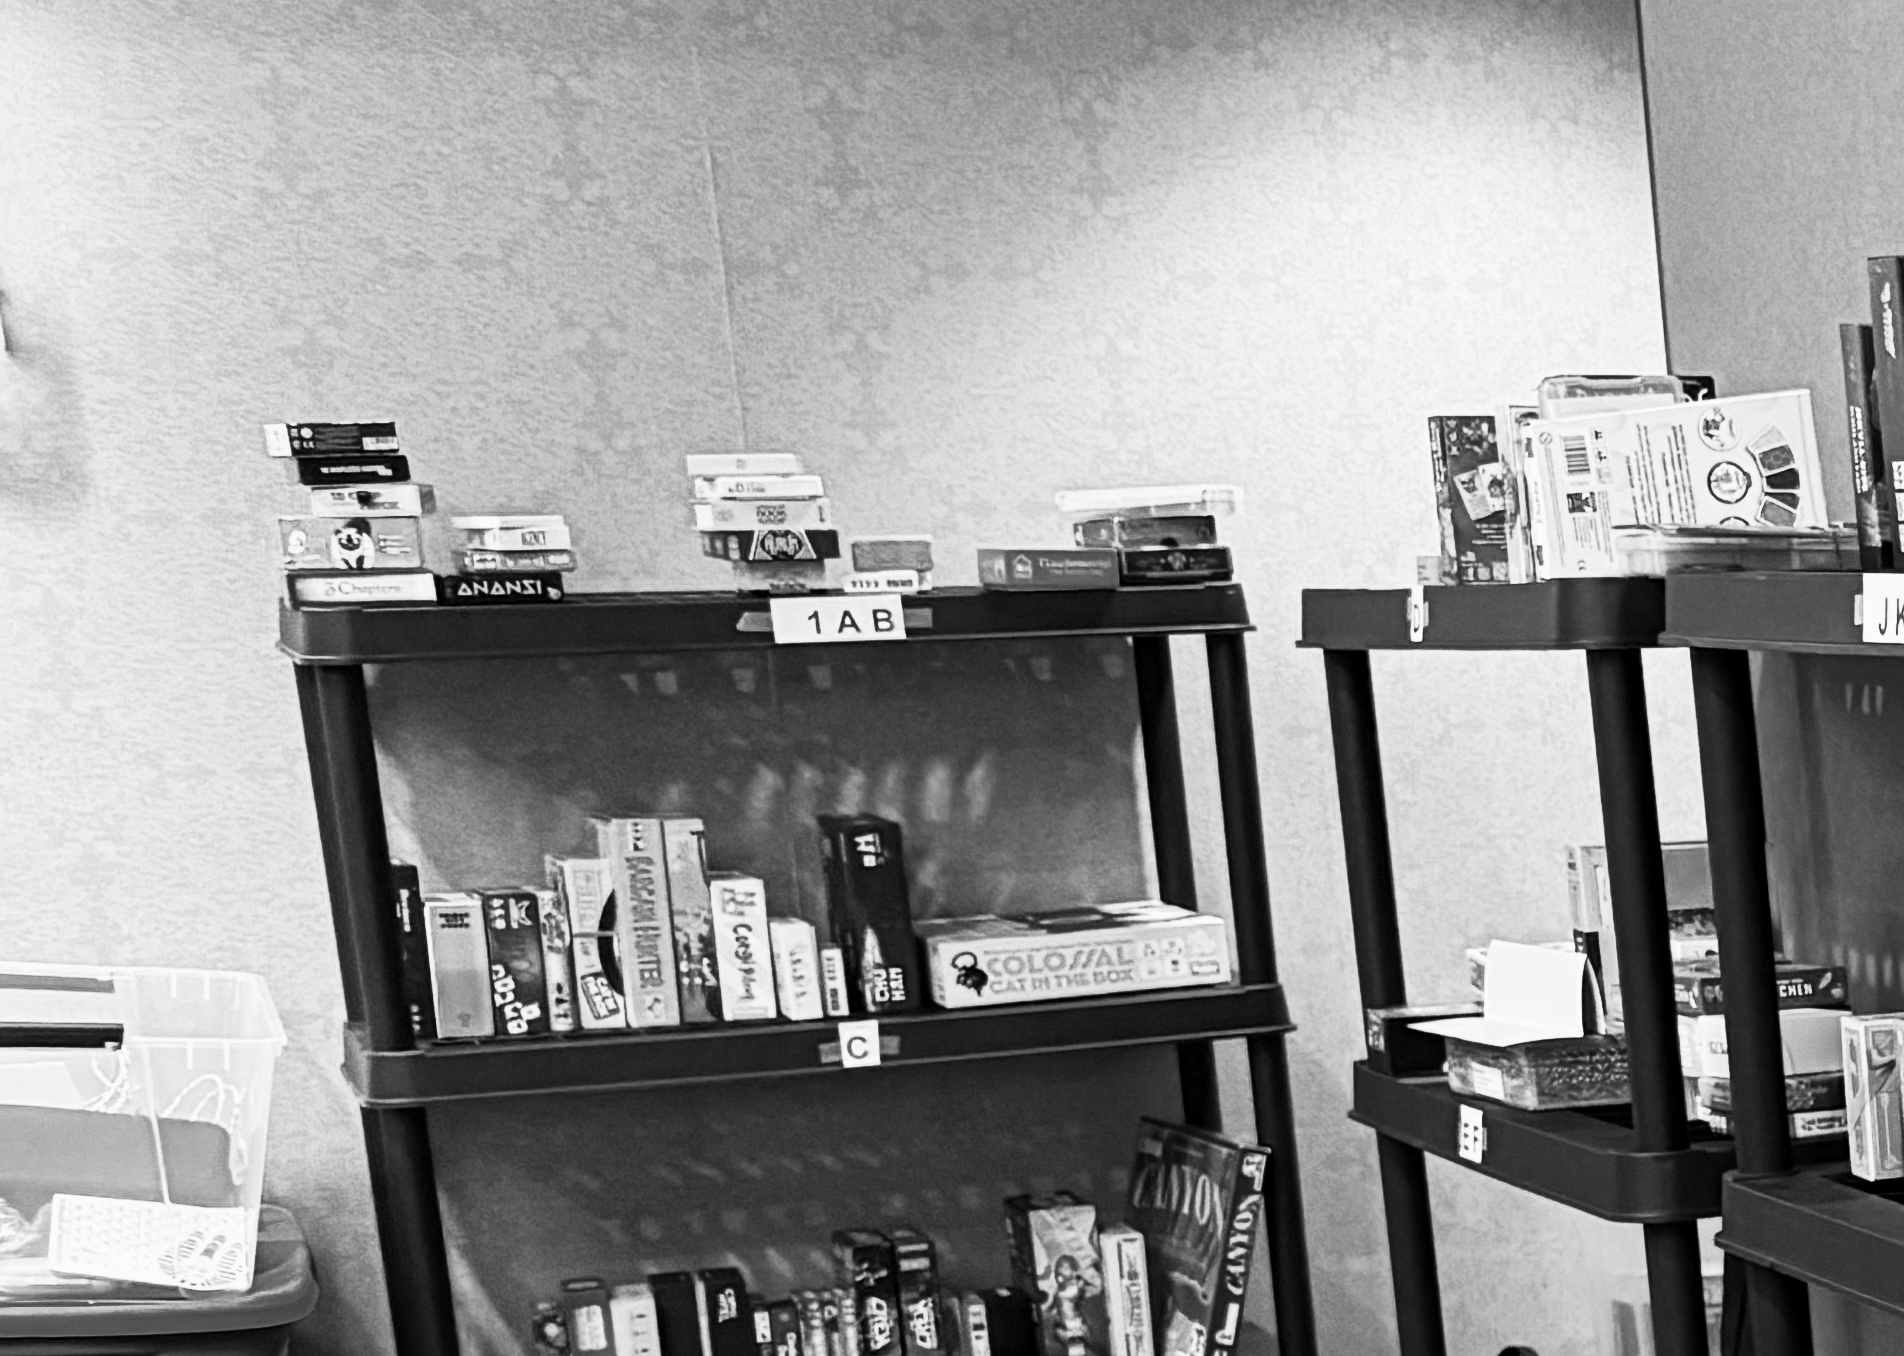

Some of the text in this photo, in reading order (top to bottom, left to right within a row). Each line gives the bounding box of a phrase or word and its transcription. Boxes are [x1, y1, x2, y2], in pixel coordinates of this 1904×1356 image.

[456, 580, 543, 597] ANANSI
[989, 975, 1028, 994] CAT
[1057, 972, 1091, 990] THE
[1096, 967, 1135, 987] BOX
[846, 1036, 868, 1060] C
